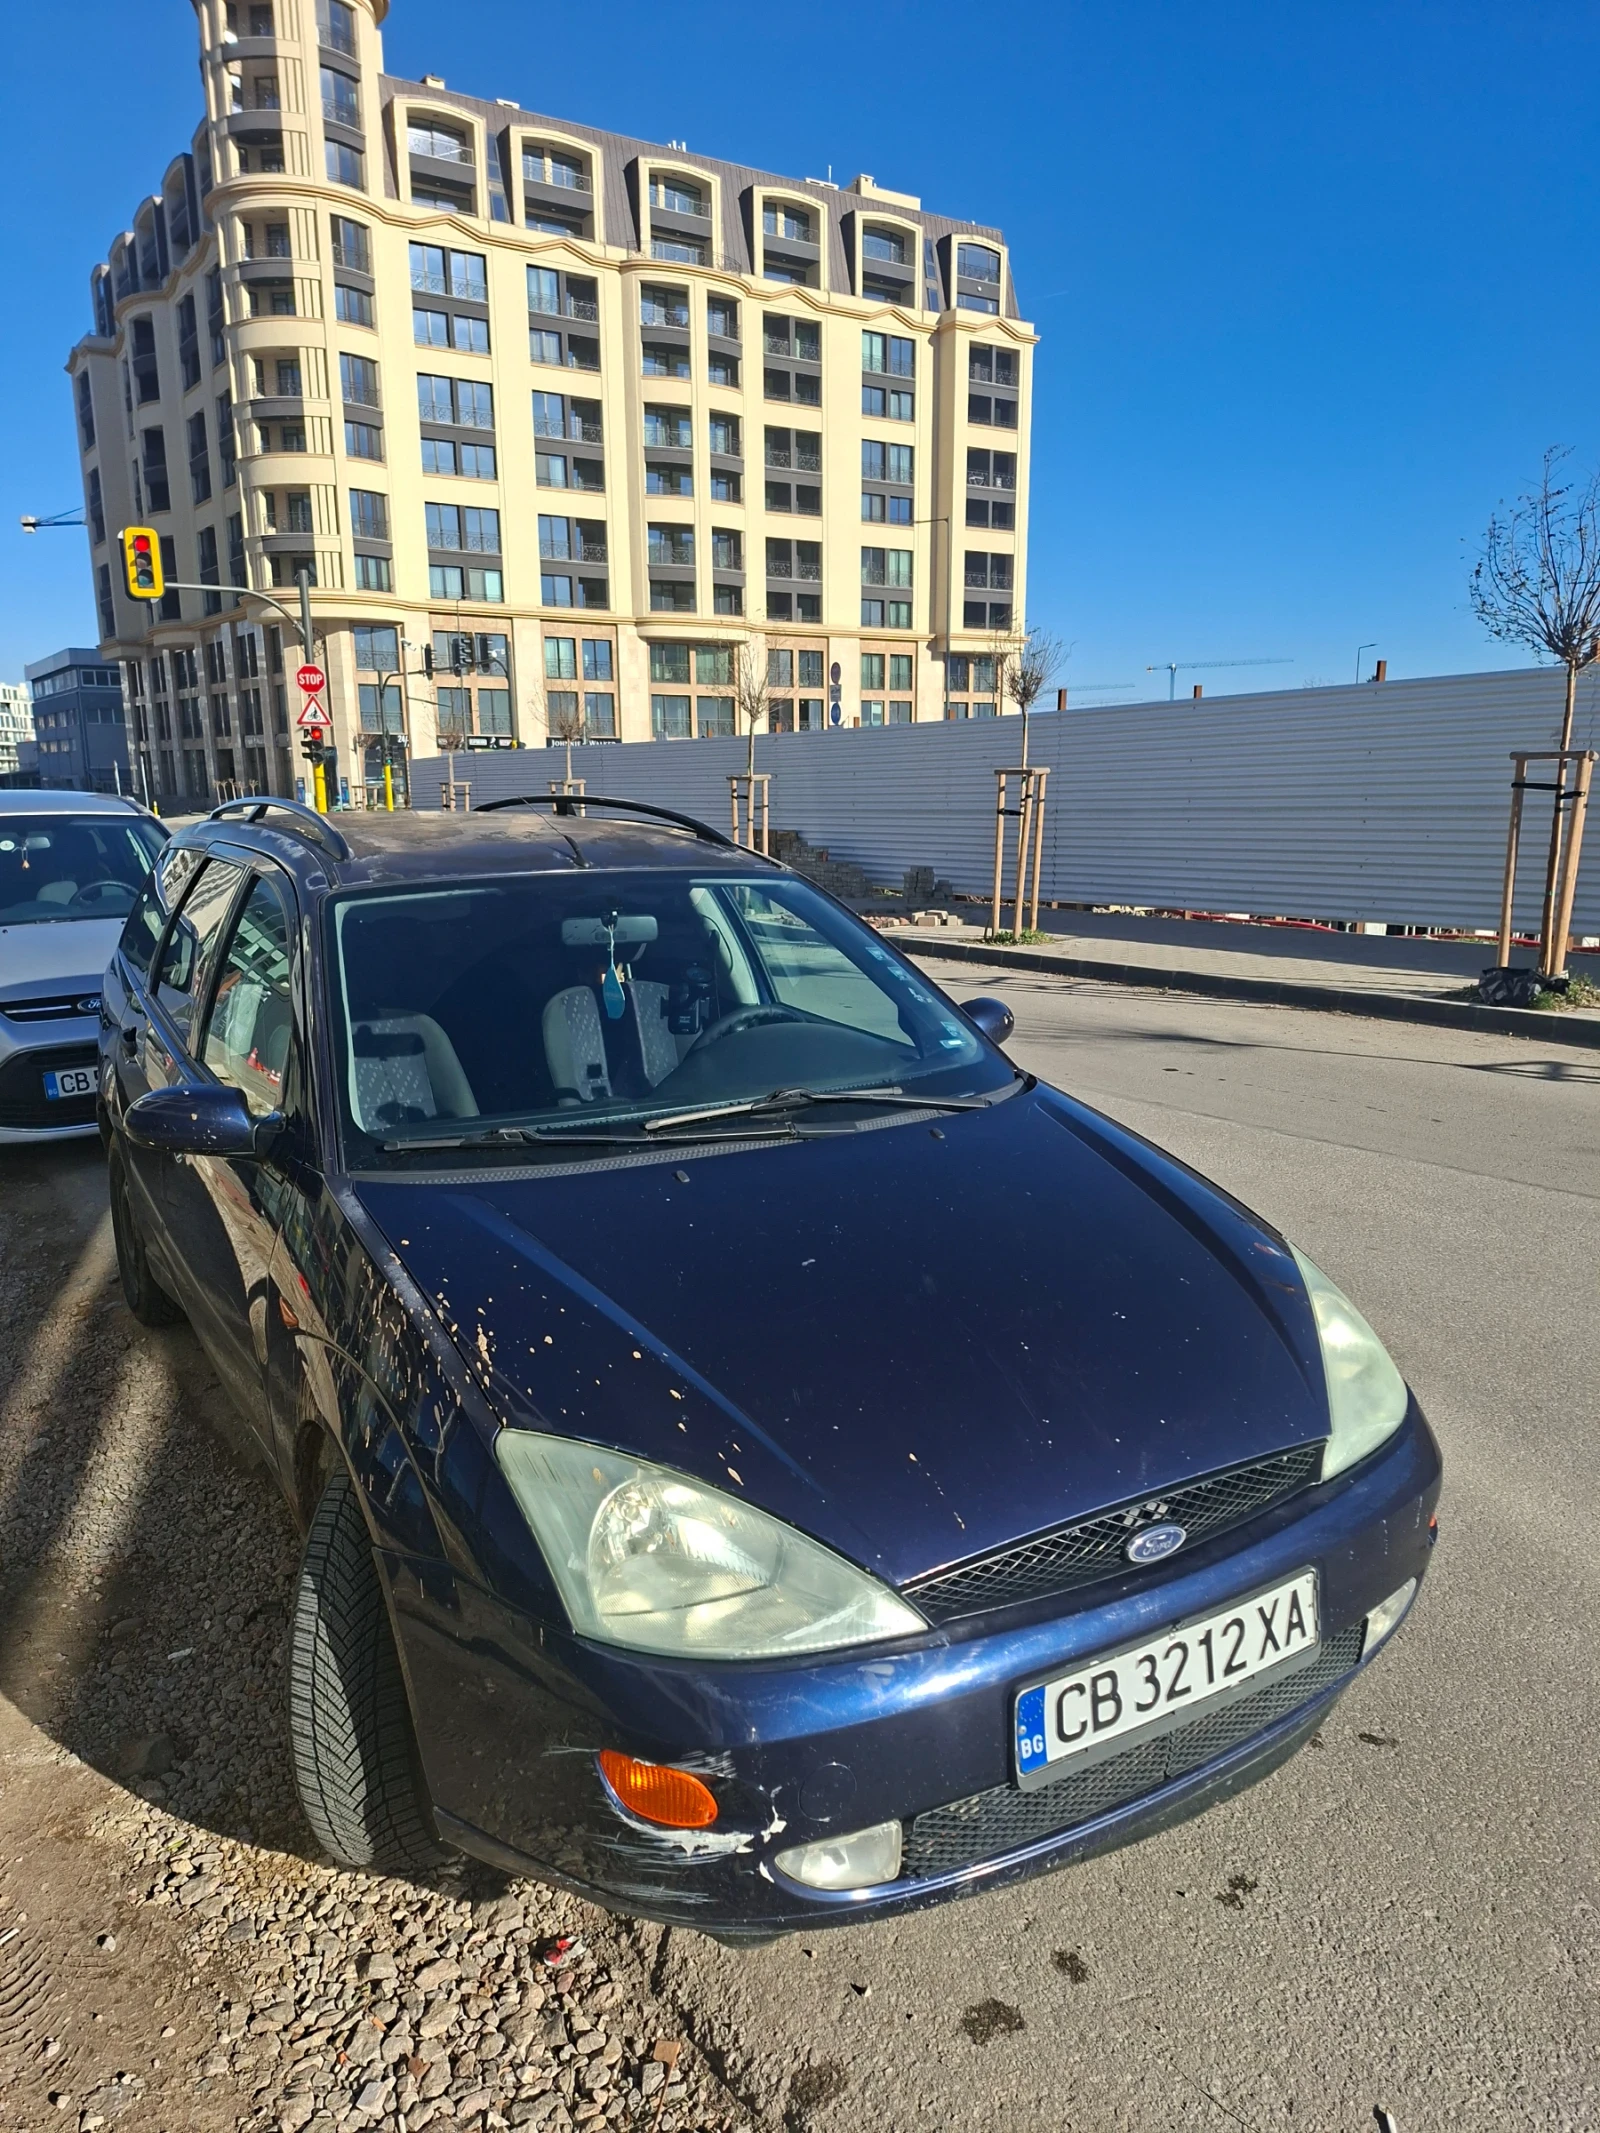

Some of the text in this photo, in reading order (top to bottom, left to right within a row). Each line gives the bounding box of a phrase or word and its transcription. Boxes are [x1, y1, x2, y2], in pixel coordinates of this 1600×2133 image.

[298, 673, 323, 685] STOP
[60, 1072, 90, 1094] CB
[1142, 1534, 1174, 1556] Ford
[1056, 1589, 1307, 1743] CB 3212 XA
[1020, 1734, 1044, 1760] BG
